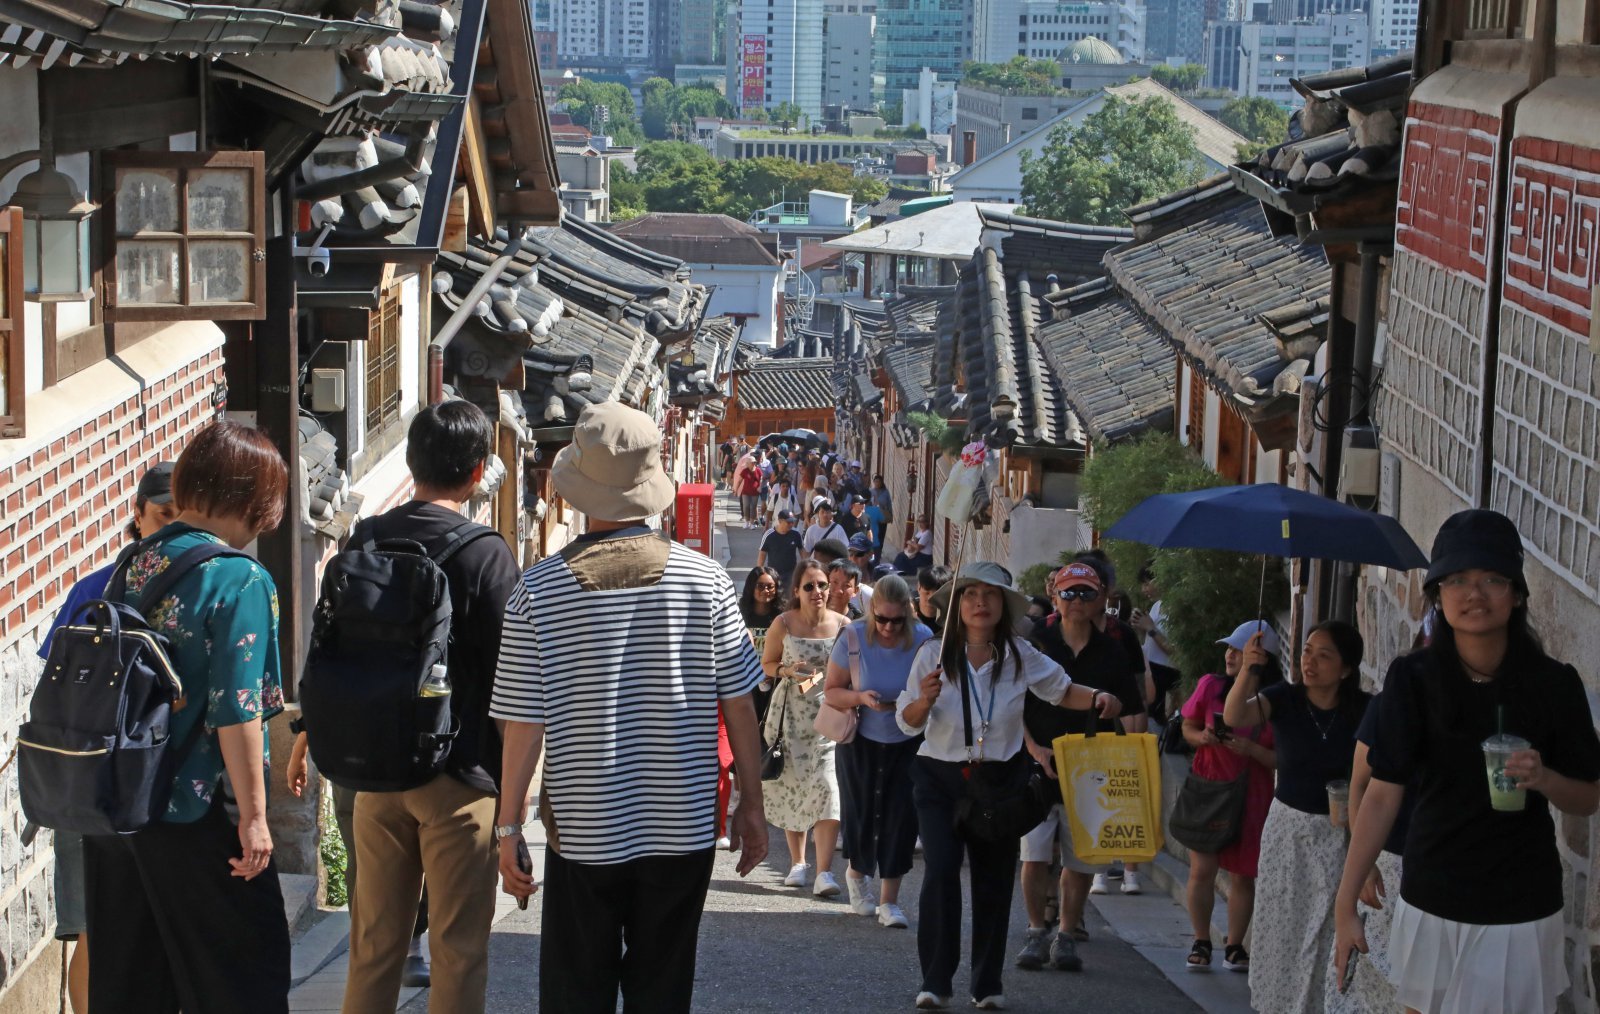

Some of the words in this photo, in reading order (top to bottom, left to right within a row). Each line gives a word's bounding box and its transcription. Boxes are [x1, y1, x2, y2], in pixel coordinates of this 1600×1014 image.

[745, 66, 763, 77] PT
[1114, 769, 1139, 778] LOVE
[1109, 779, 1140, 788] CLEAN
[1103, 825, 1145, 839] SAVE
[1100, 840, 1122, 849] OUR
